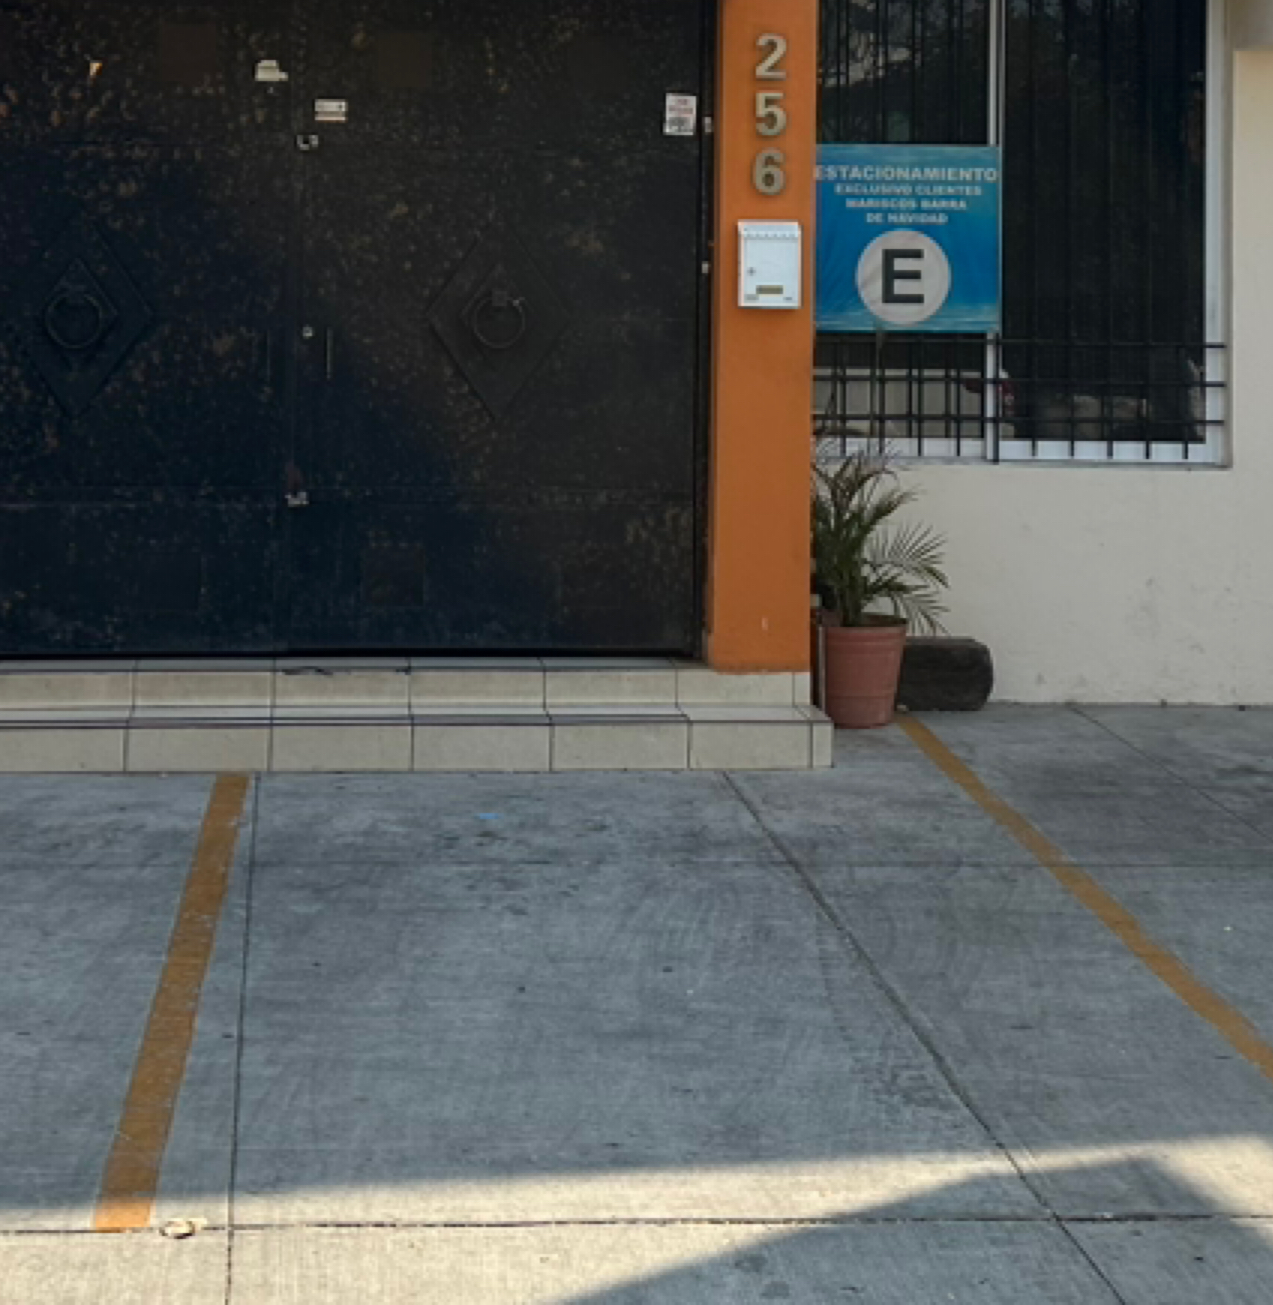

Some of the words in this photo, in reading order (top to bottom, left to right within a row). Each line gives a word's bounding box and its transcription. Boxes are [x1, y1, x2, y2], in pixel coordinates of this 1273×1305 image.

[813, 164, 997, 182] ESTACIONAMIENTO
[865, 213, 883, 224] DE
[887, 213, 949, 225] NAVIDAD
[882, 248, 925, 304] E
